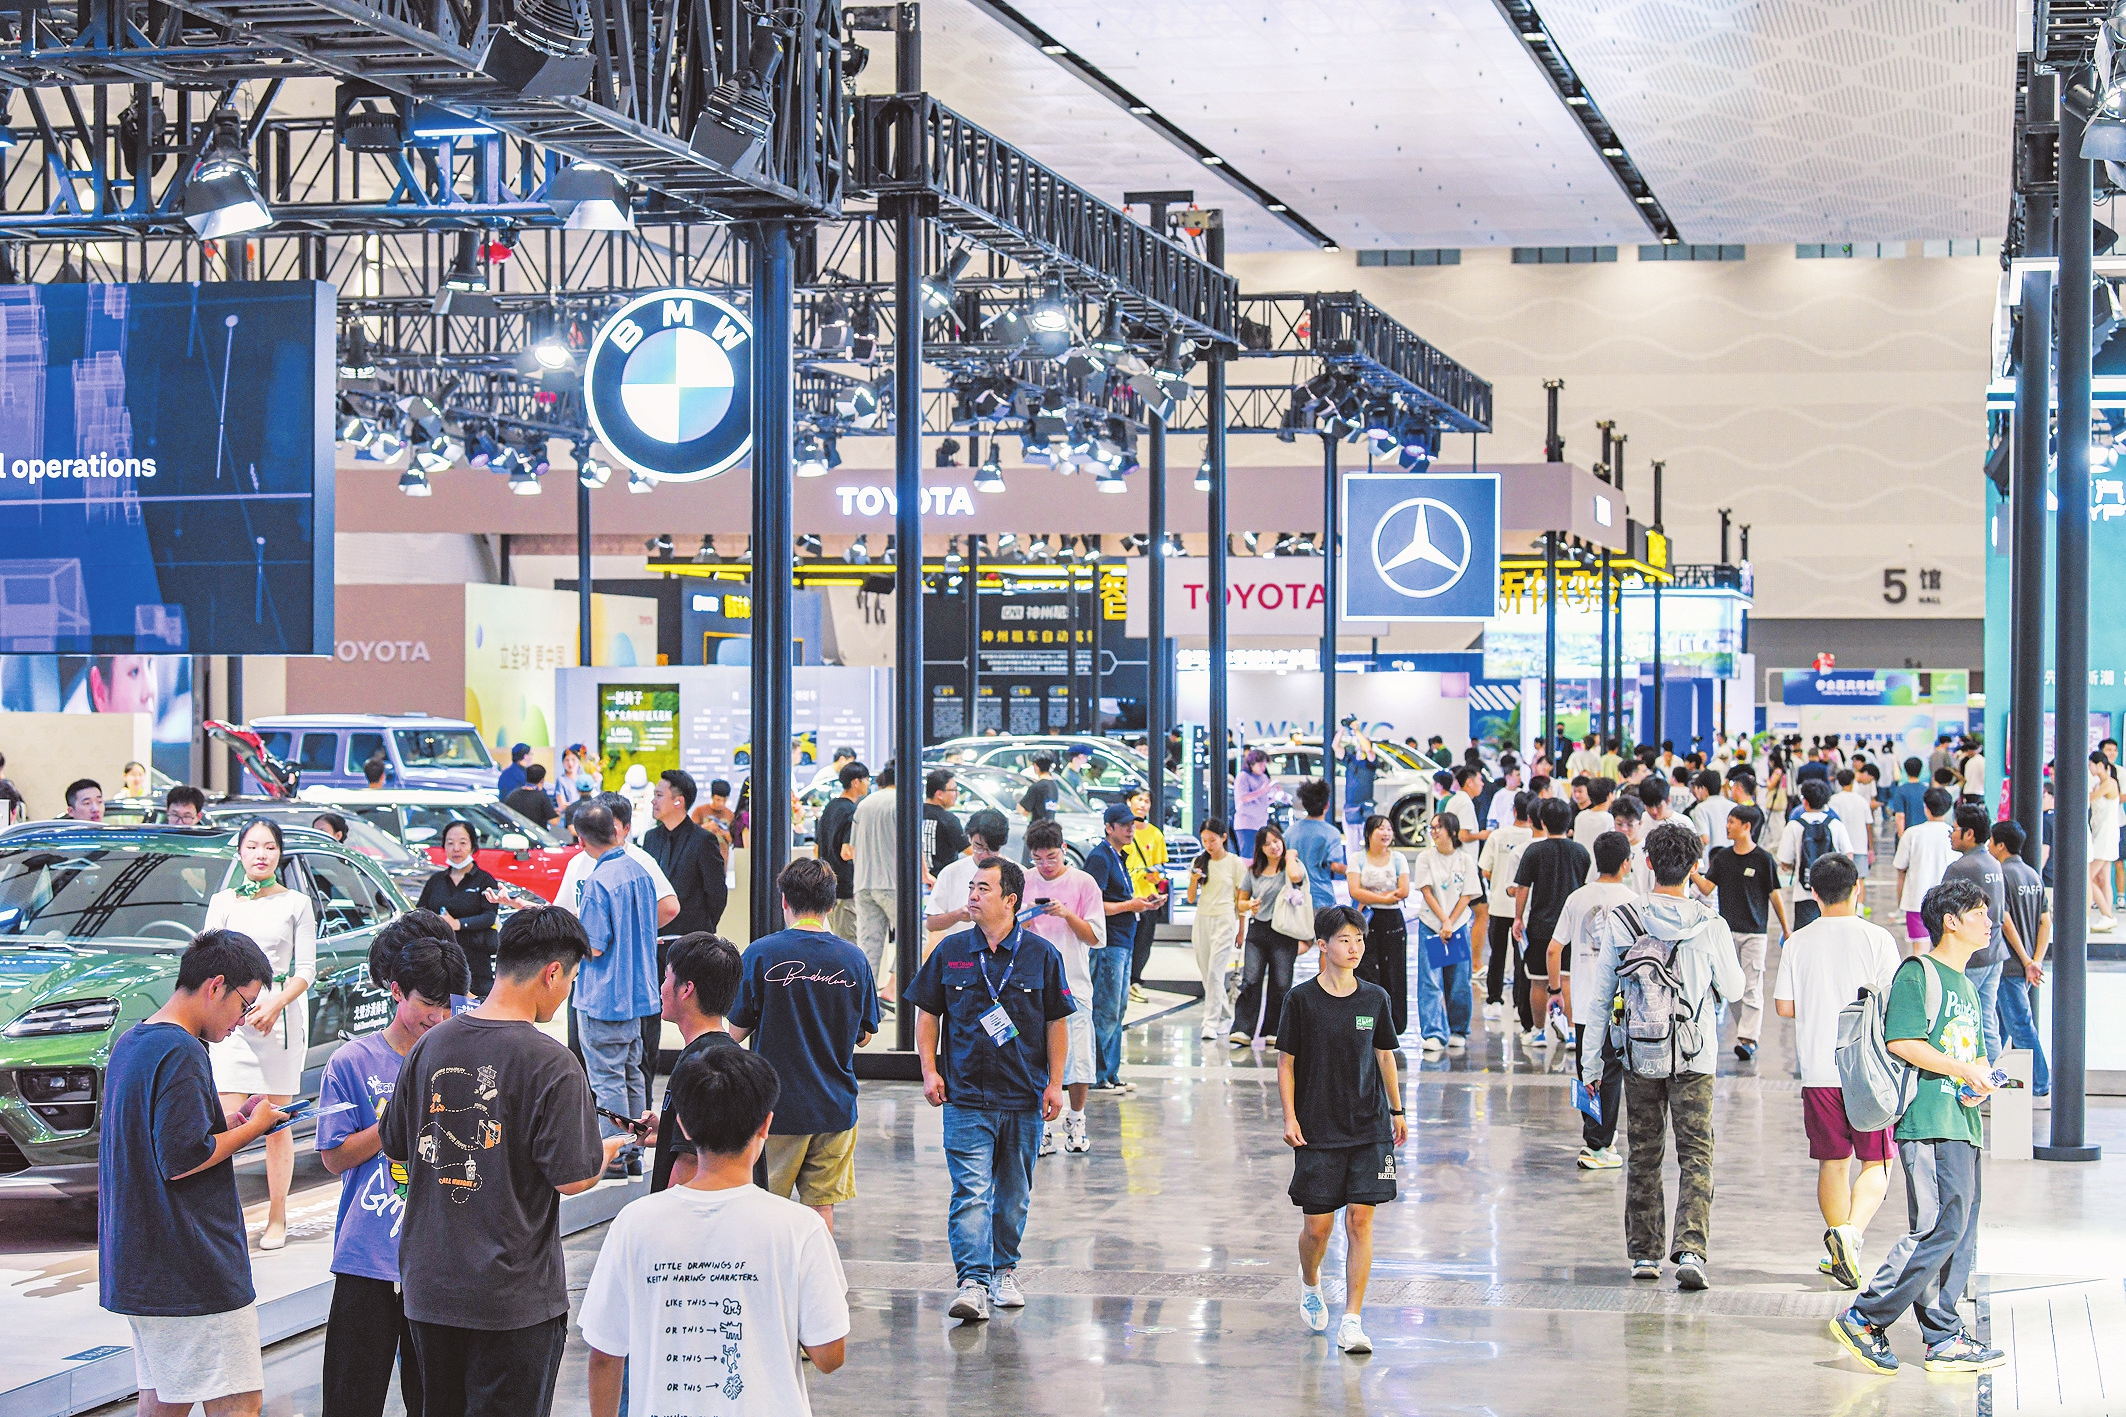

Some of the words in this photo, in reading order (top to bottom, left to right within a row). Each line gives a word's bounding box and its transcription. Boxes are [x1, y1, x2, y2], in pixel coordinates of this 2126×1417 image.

[609, 299, 748, 354] BMW
[12, 451, 157, 485] operations
[1919, 567, 1941, 589] 馆
[1883, 569, 1907, 604] 5
[327, 640, 431, 663] OYOTA
[2018, 884, 2041, 896] STAFF
[654, 1262, 682, 1271] LITTLE
[687, 1261, 732, 1270] DRAWINGS
[735, 1261, 746, 1270] OF
[646, 1274, 668, 1284] KEITH
[673, 1274, 706, 1282] HARING
[710, 1273, 759, 1282] CHARACTERS.
[665, 1299, 683, 1307] LIKE
[665, 1326, 677, 1334] OR
[682, 1326, 704, 1334] THIS
[666, 1354, 678, 1362] OR
[682, 1354, 702, 1363] THIS
[666, 1383, 679, 1391] OR
[683, 1383, 702, 1392] THIS
